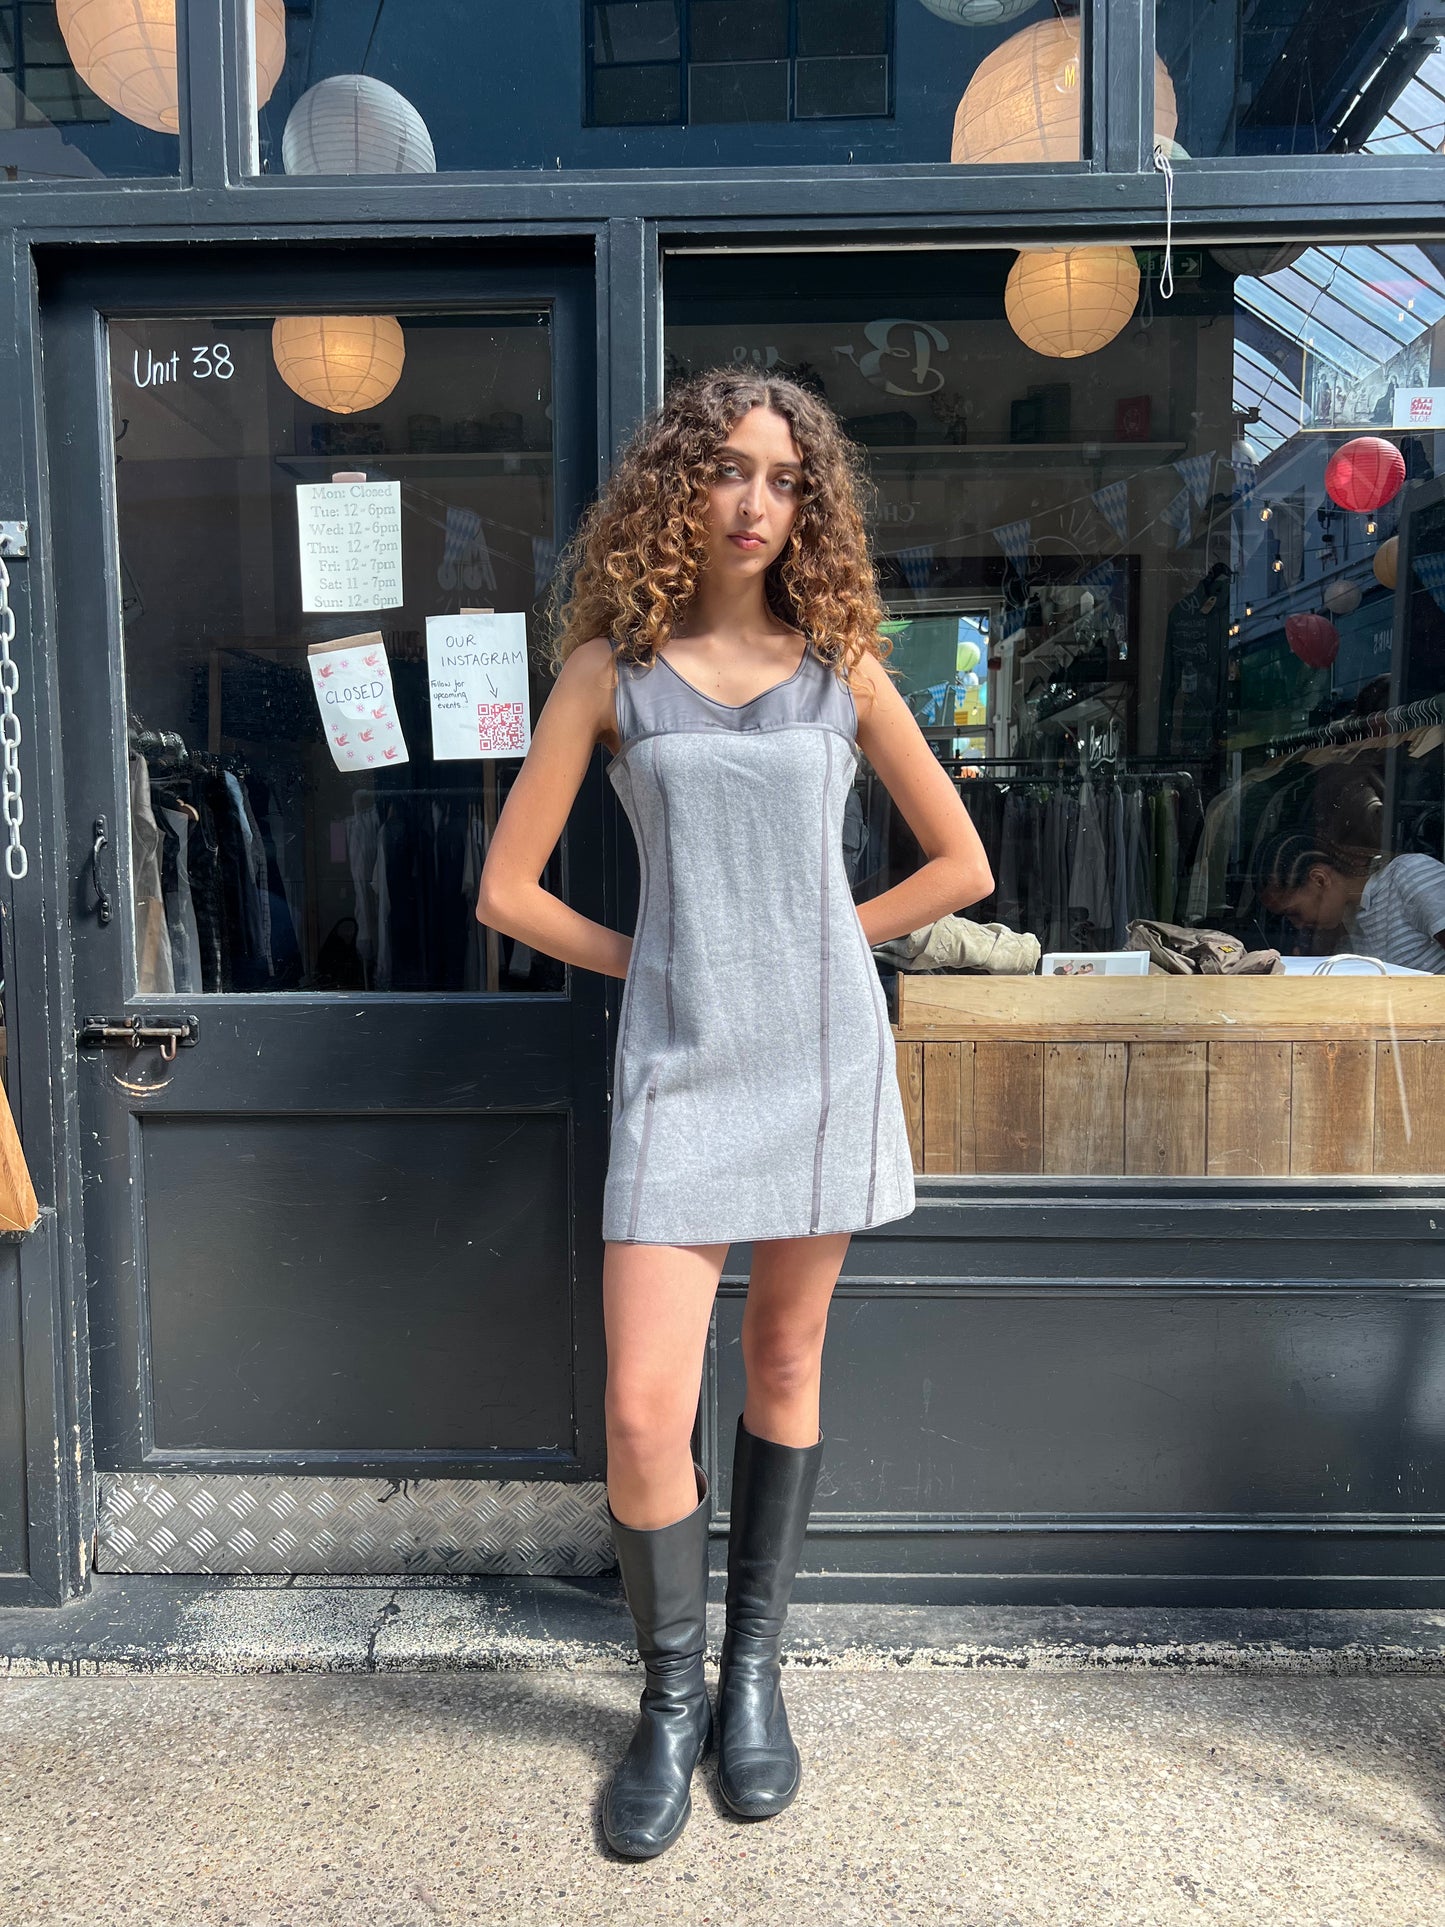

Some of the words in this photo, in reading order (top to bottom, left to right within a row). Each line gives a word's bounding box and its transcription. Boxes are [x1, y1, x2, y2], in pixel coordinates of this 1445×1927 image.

[134, 349, 180, 388] Unit
[191, 343, 235, 379] 38
[312, 487, 346, 500] Mon:
[349, 485, 392, 498] Closed
[310, 506, 339, 518] Tue:
[309, 523, 344, 536] Wed:
[307, 542, 339, 554] Thu:
[318, 560, 341, 572] Fri:
[319, 578, 342, 590] Sat:
[314, 596, 343, 608] Sun:
[445, 634, 477, 648] OUR
[441, 650, 524, 667] INSTAGRAM
[430, 680, 451, 688] Follow
[454, 680, 464, 692] for
[325, 681, 384, 705] CLOSED
[433, 692, 468, 703] upcoming
